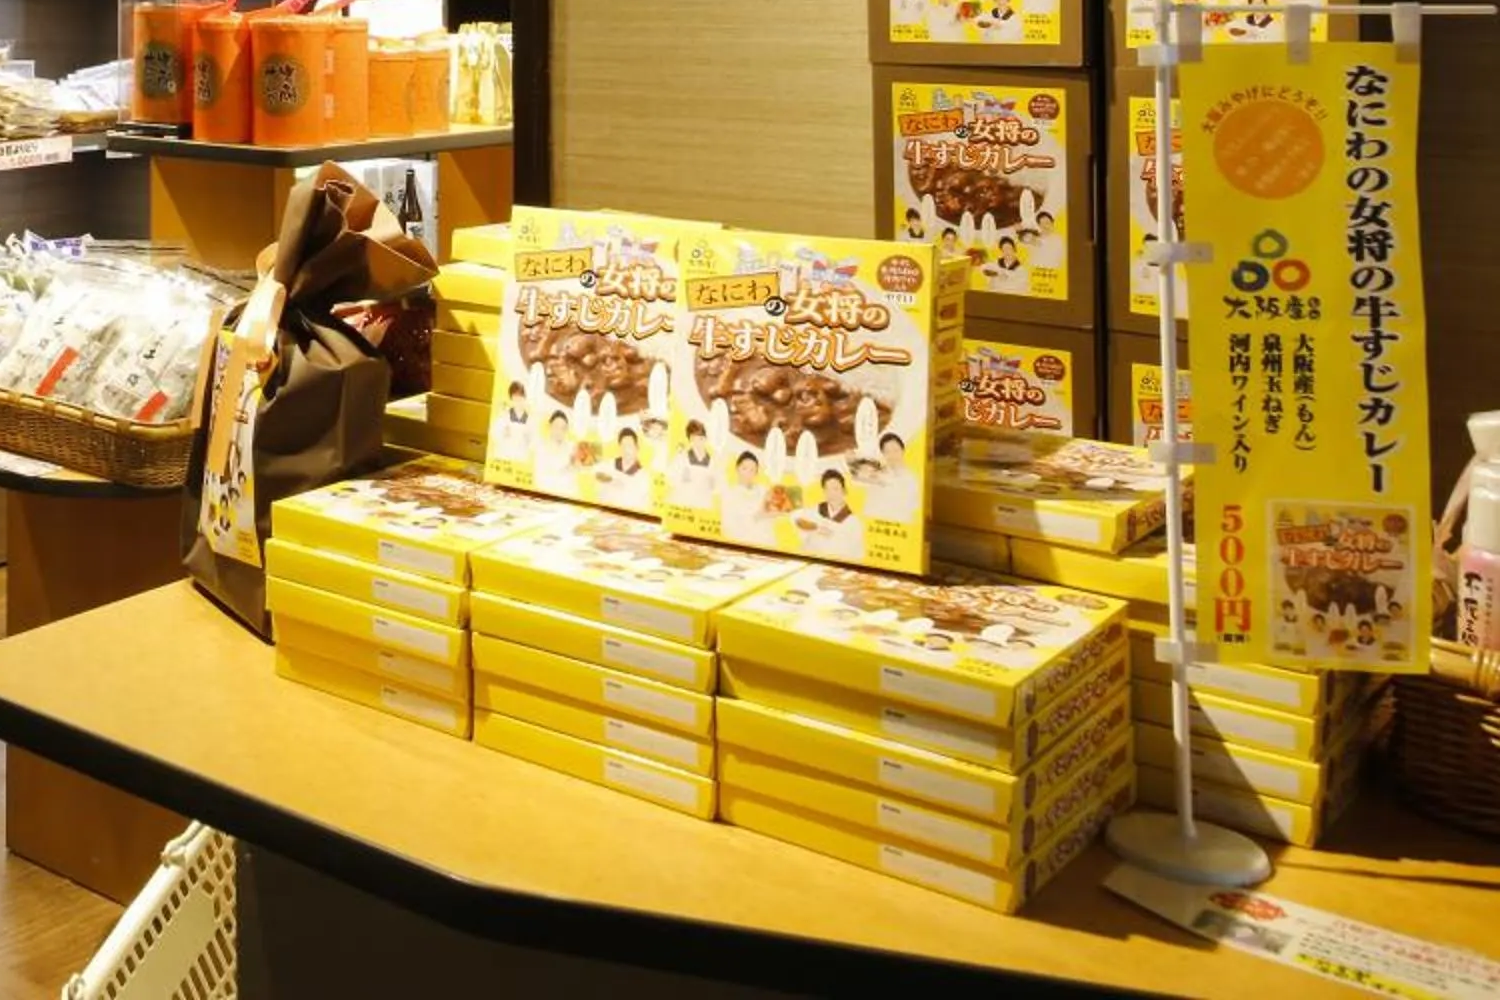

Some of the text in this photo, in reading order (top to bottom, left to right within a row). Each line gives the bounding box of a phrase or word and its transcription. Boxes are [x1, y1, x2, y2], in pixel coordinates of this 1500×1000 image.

[903, 139, 1055, 174] 牛すじカレー
[695, 279, 891, 331] なにわの女将の
[1345, 65, 1400, 493] なにわの女将の牛すじカレー
[514, 284, 675, 340] 牛すじカレ
[688, 315, 912, 373] 牛すじカレー
[1230, 334, 1251, 473] 河内ワイン入り
[1214, 504, 1251, 633] 500円
